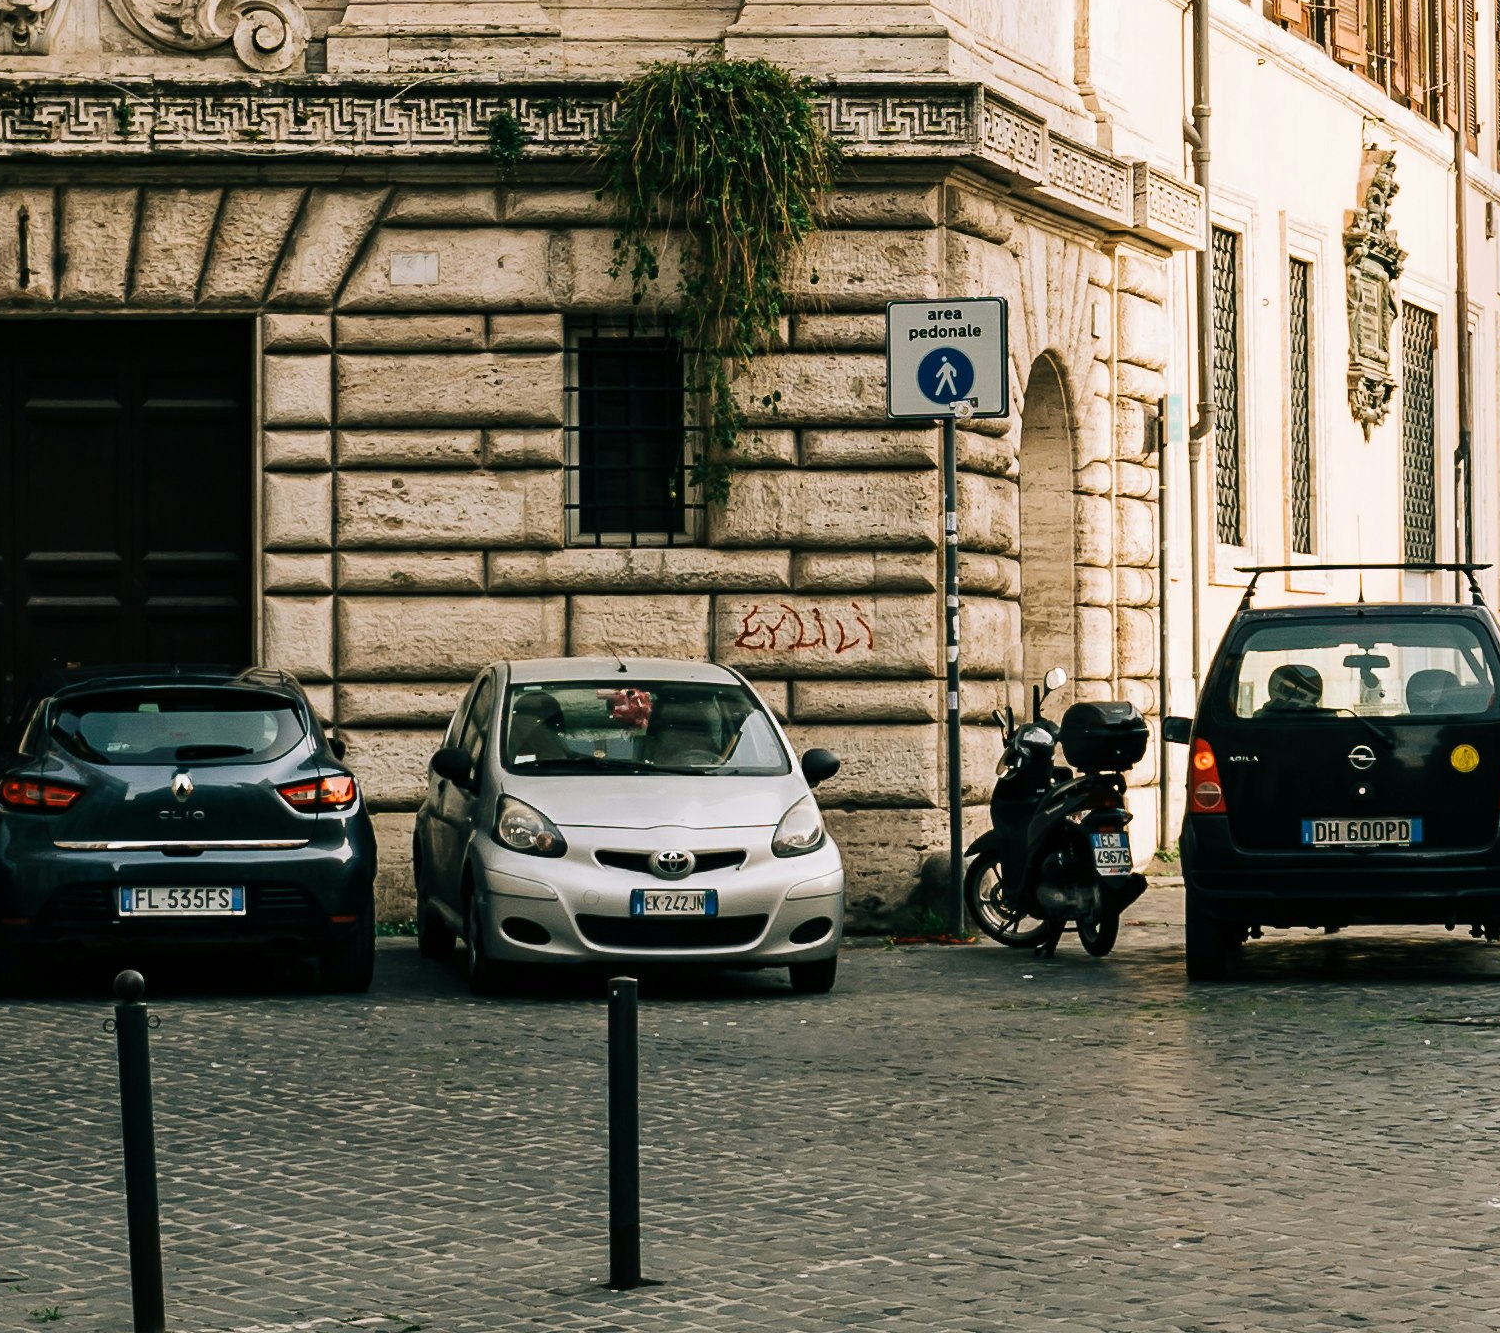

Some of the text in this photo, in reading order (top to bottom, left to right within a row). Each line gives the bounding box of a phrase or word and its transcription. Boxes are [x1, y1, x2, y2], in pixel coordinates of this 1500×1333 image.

[927, 309, 963, 321] area
[908, 323, 982, 342] pedonale
[158, 810, 205, 820] CLIO
[1097, 849, 1131, 865] 49676
